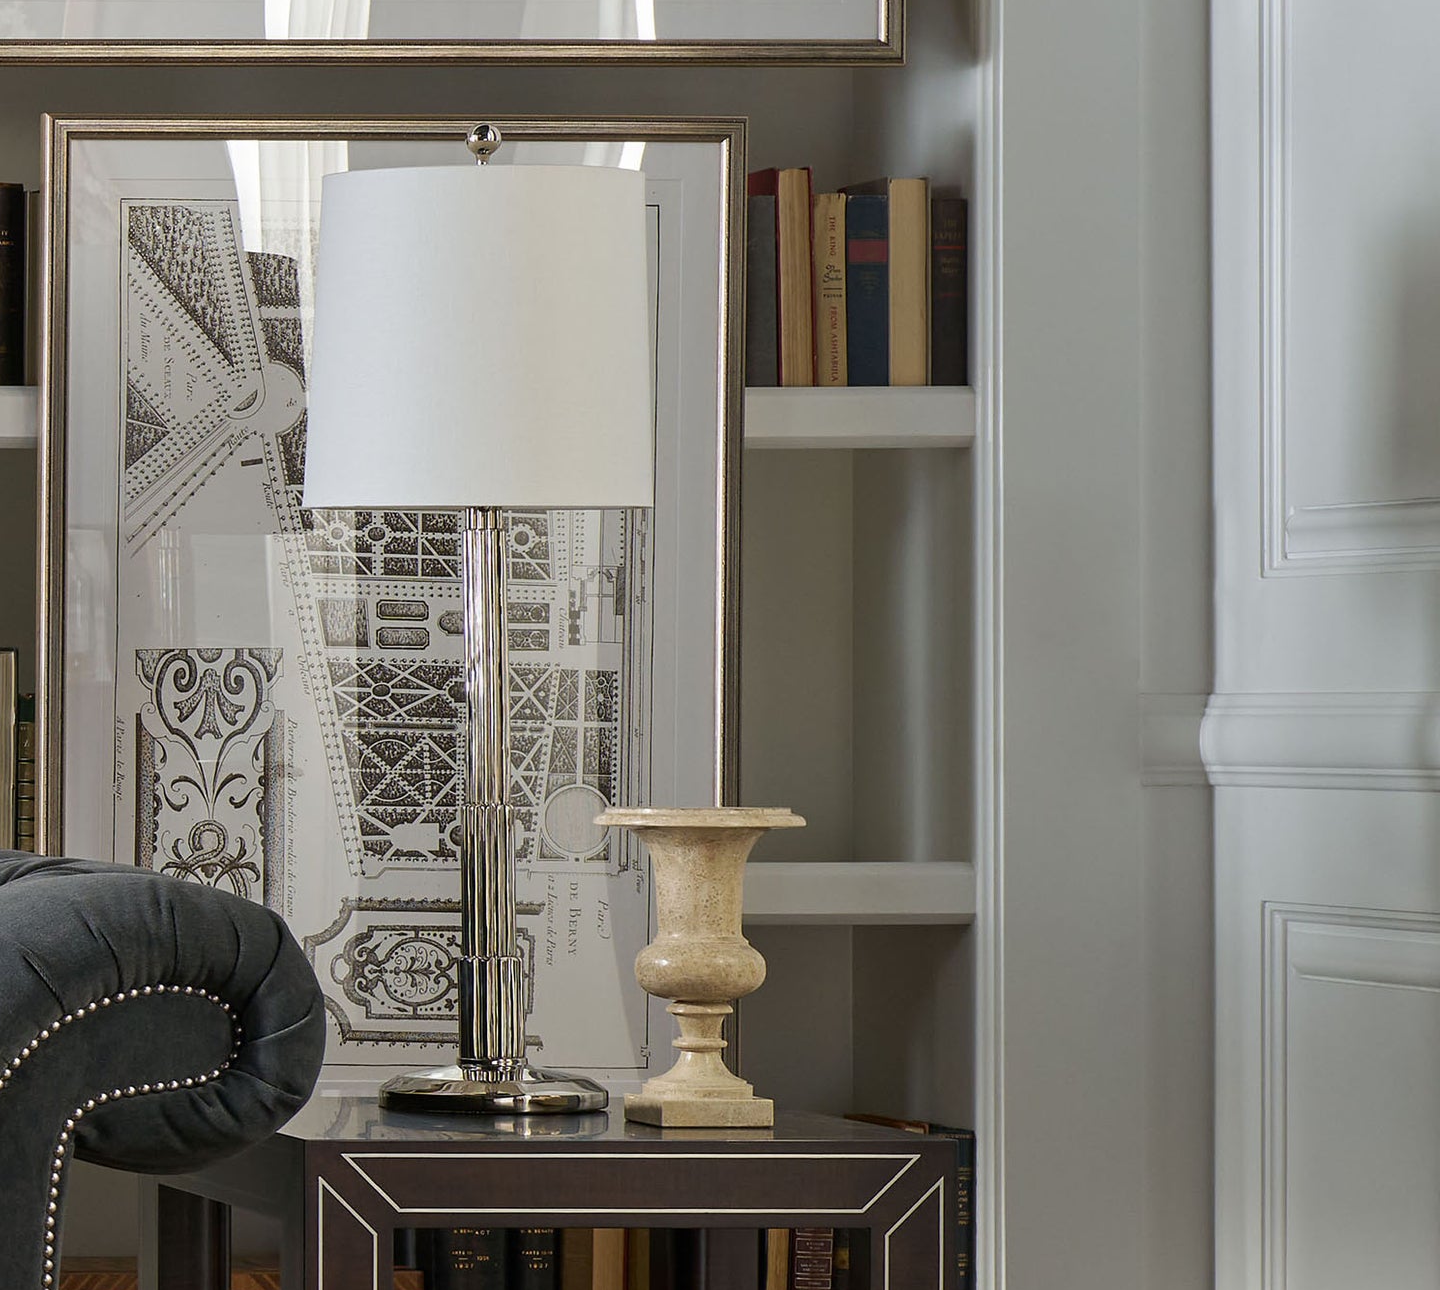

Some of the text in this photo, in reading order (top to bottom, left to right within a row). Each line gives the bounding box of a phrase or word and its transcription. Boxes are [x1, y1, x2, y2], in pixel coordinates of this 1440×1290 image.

[828, 237, 836, 257] KING
[567, 881, 582, 956] DE BERNY
